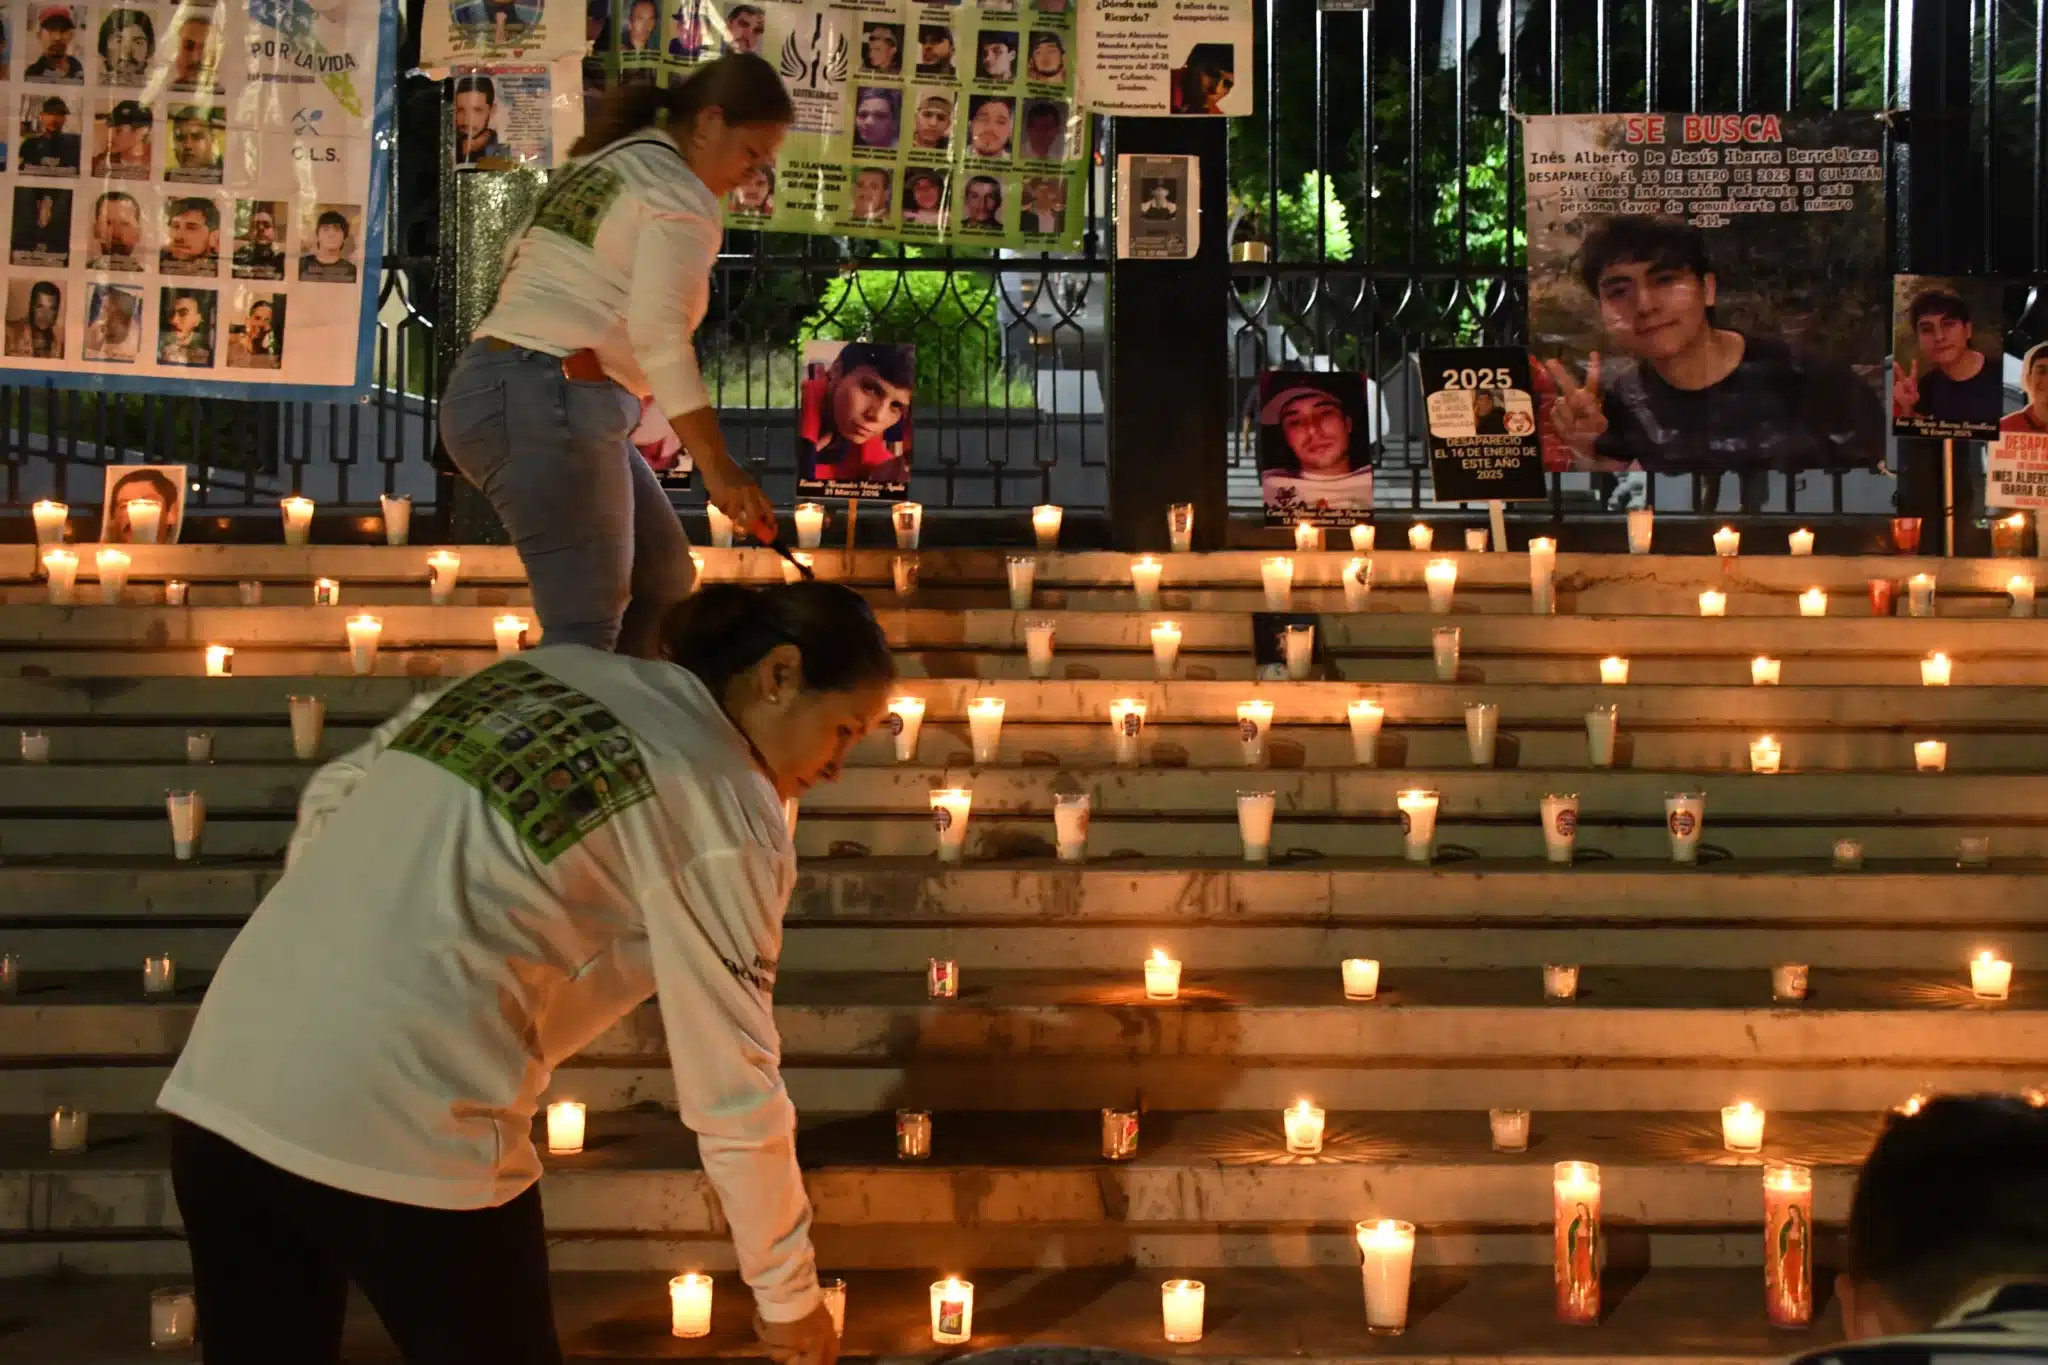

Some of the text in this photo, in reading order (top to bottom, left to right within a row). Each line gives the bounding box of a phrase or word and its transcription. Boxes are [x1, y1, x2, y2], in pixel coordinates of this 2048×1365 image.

[1104, 12, 1150, 22] Ricardo?
[1096, 31, 1127, 39] Ricardo
[251, 40, 356, 72] POR LA VIDA
[1626, 114, 1783, 144] SE BUSCA
[291, 147, 341, 162] CL.S.
[1530, 147, 1880, 165] Inés Alberto De Jesús Ibarra Berrelleza
[1619, 169, 1636, 183] EL
[1641, 169, 1659, 183] 16
[1664, 169, 1683, 183] DE
[1688, 168, 1729, 183] ENERO
[1734, 168, 1752, 182] DE
[1756, 168, 1791, 182] 2025
[1795, 167, 1814, 182] EN
[1560, 183, 1854, 199] Si tienes información referente a esta
[1560, 198, 1853, 214] persona favor de comunicarte al número
[1441, 367, 1513, 390] 2025
[2005, 435, 2048, 450] DESAPA
[1434, 446, 1537, 459] EL 16 DE ENERO DE
[1462, 456, 1521, 470] ESTE AÑO
[1476, 469, 1504, 479] 2025
[2015, 470, 2048, 484] ALBERT
